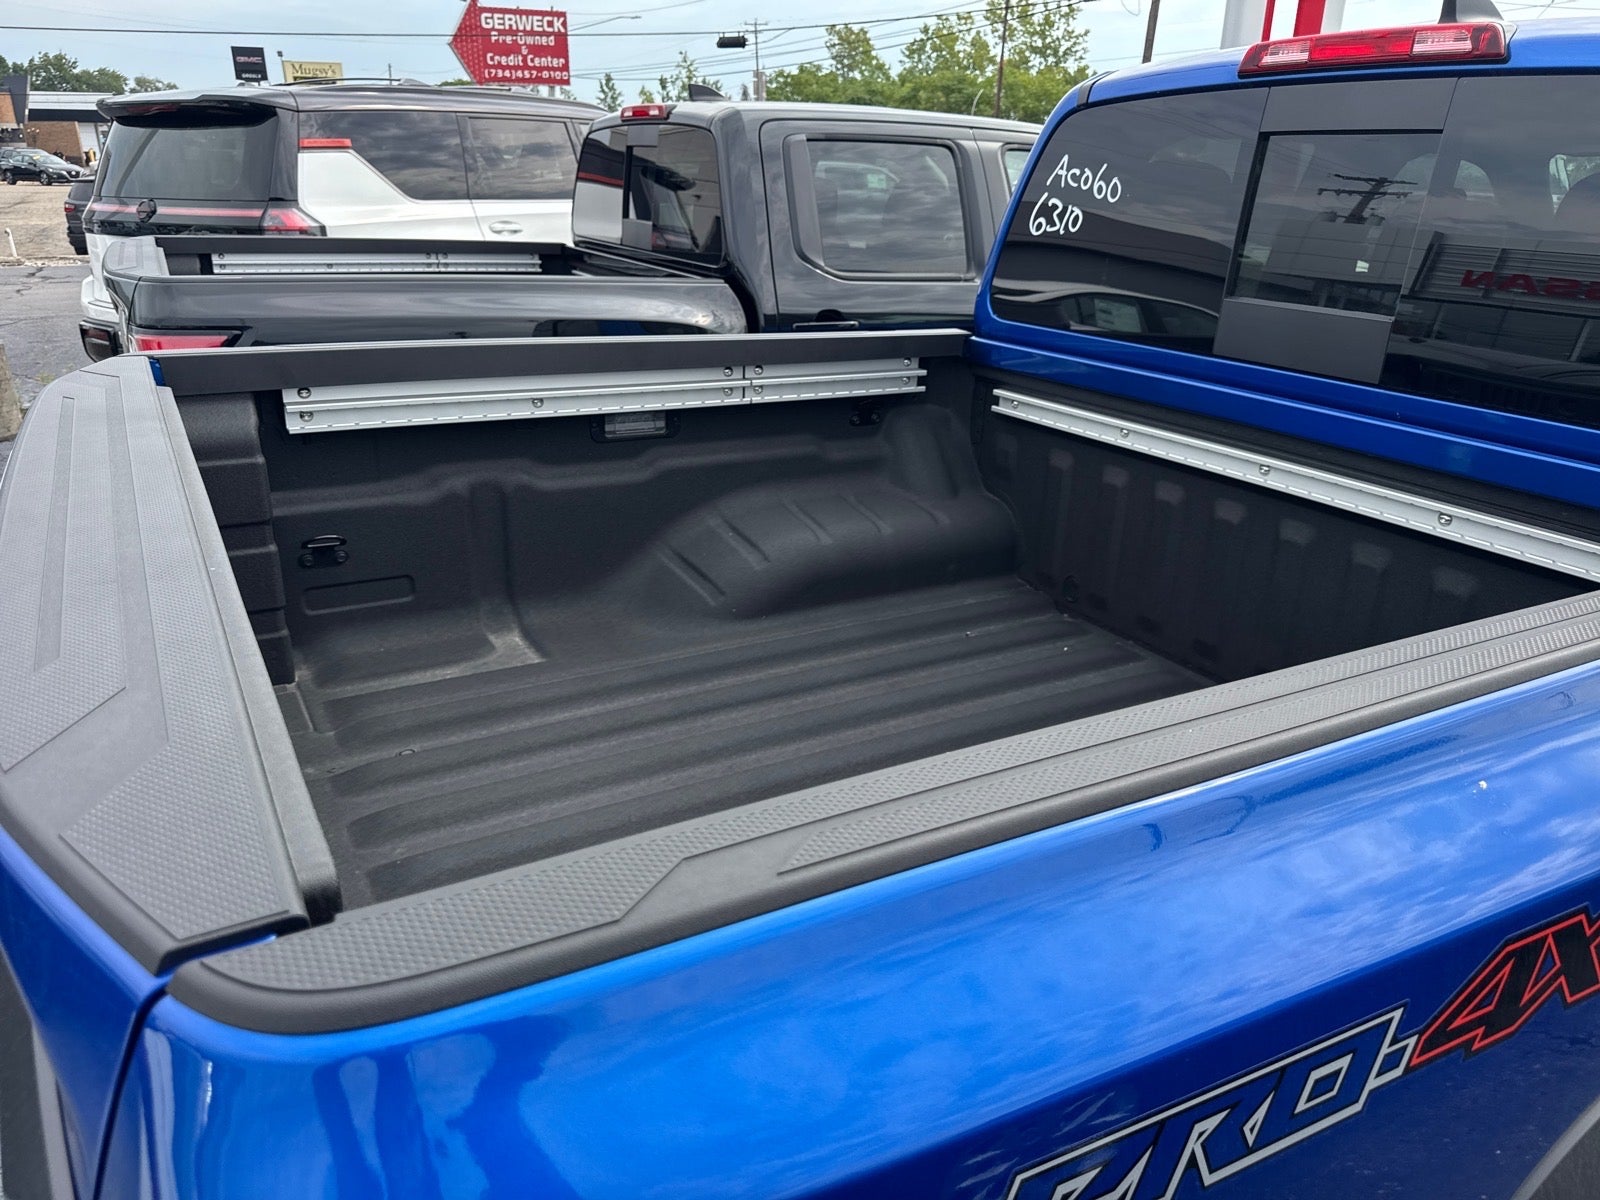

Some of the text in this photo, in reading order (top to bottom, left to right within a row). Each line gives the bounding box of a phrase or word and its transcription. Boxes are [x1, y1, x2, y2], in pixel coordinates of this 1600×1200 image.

[481, 13, 565, 32] GERWECK
[491, 31, 555, 46] Pre-Owned
[521, 46, 528, 55] &
[486, 53, 565, 67] Credit Center
[291, 63, 337, 77] Mugsy's
[1029, 192, 1083, 236] 6310
